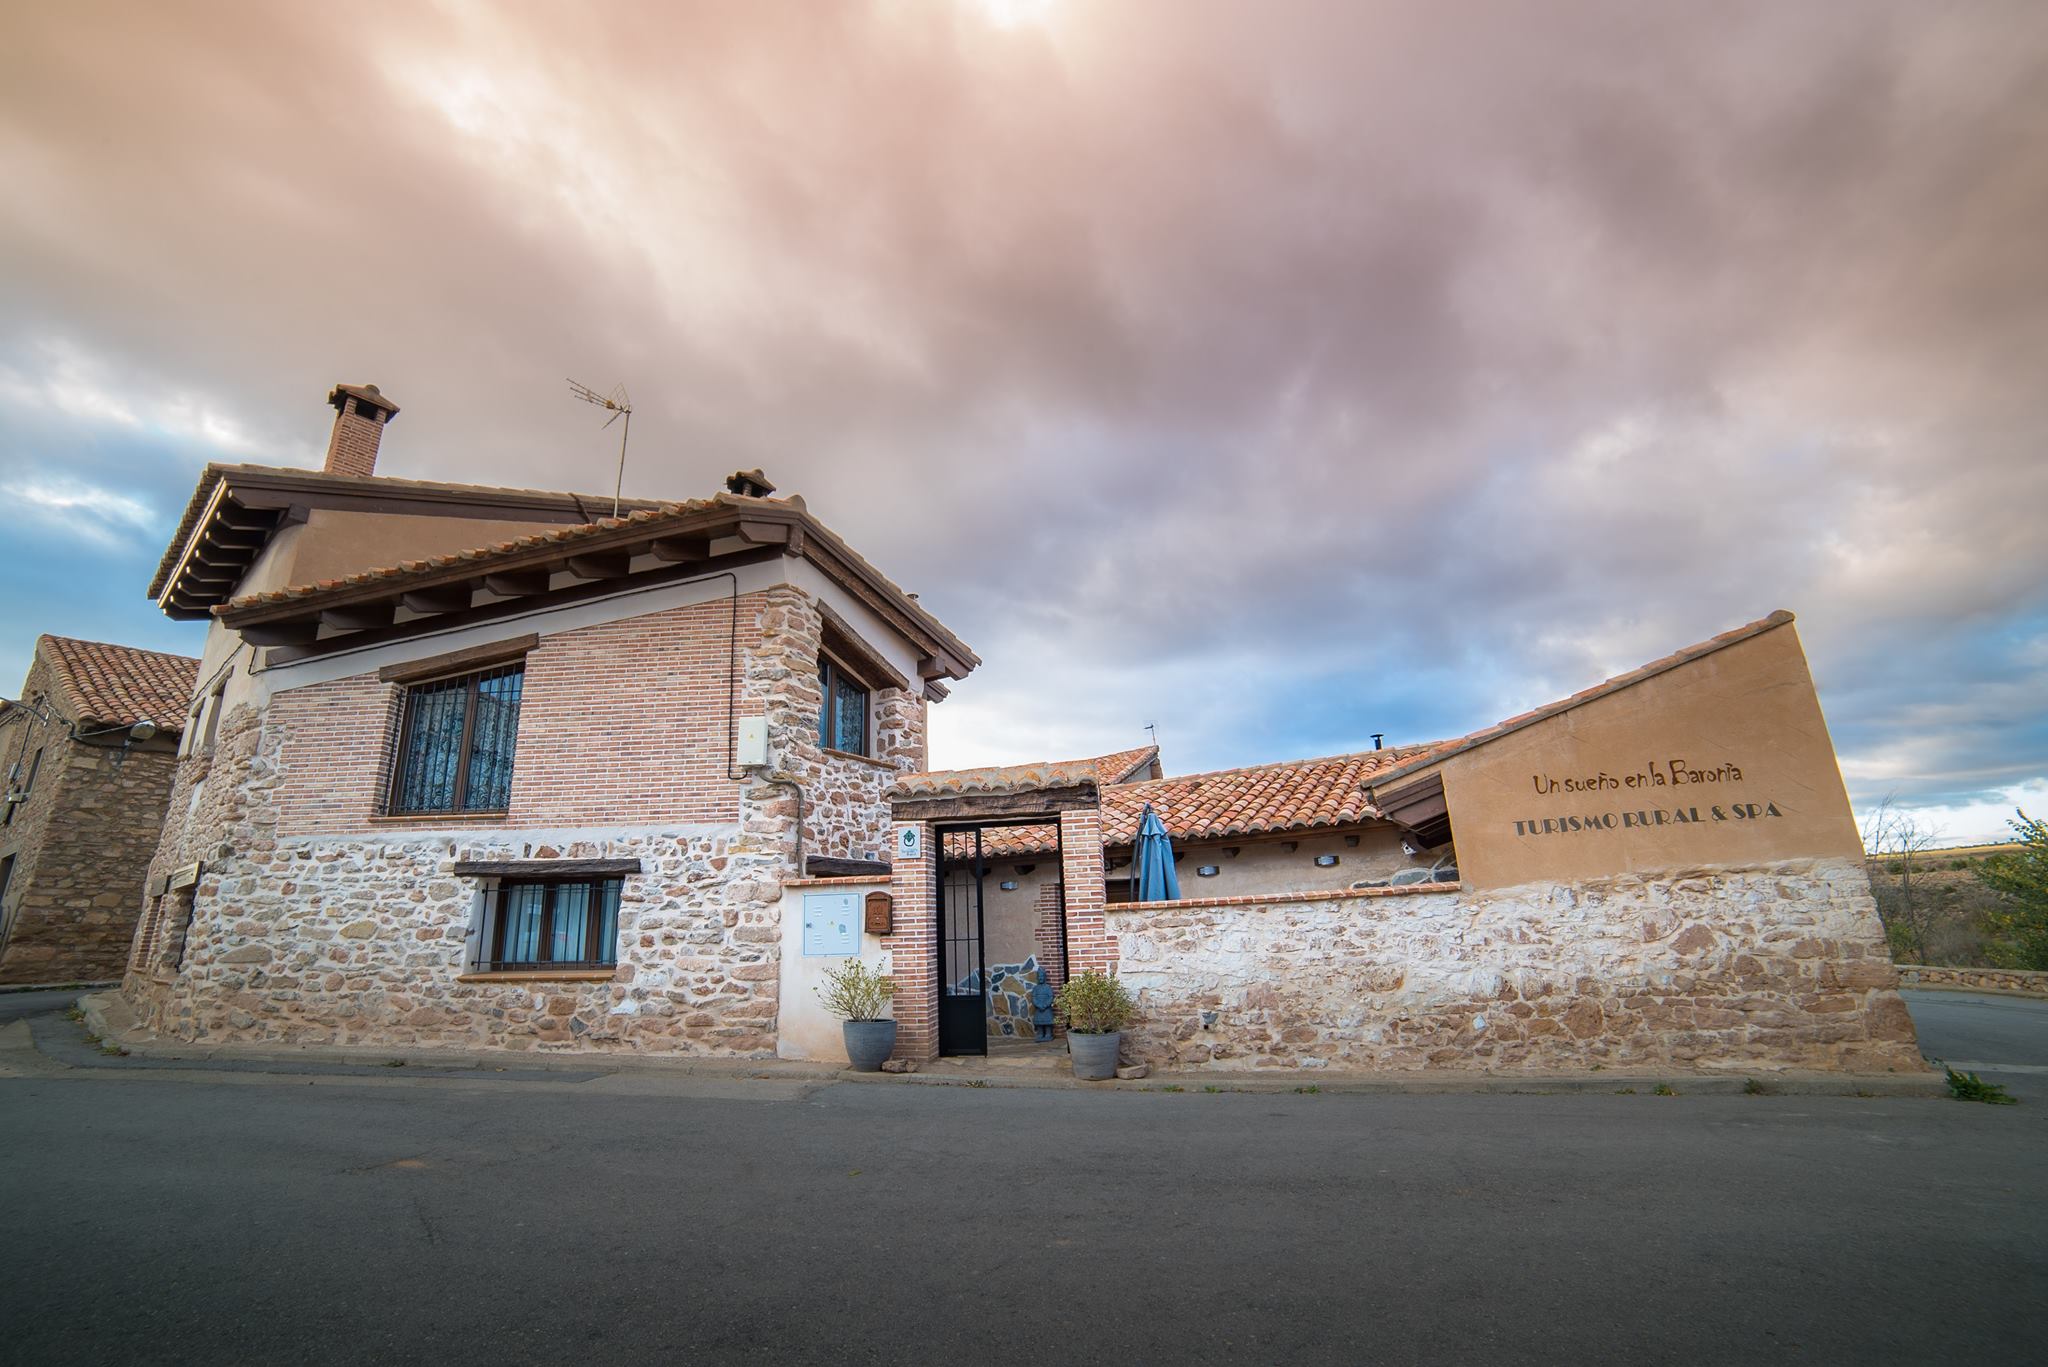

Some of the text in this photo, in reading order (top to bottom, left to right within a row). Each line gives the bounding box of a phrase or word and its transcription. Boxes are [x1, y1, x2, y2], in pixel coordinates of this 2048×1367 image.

[1533, 773, 1560, 794] Un
[1564, 772, 1619, 792] sueño
[1625, 773, 1648, 788] en
[1648, 761, 1666, 787] la
[1512, 802, 1783, 836] TURISMO RURAL & SPA
